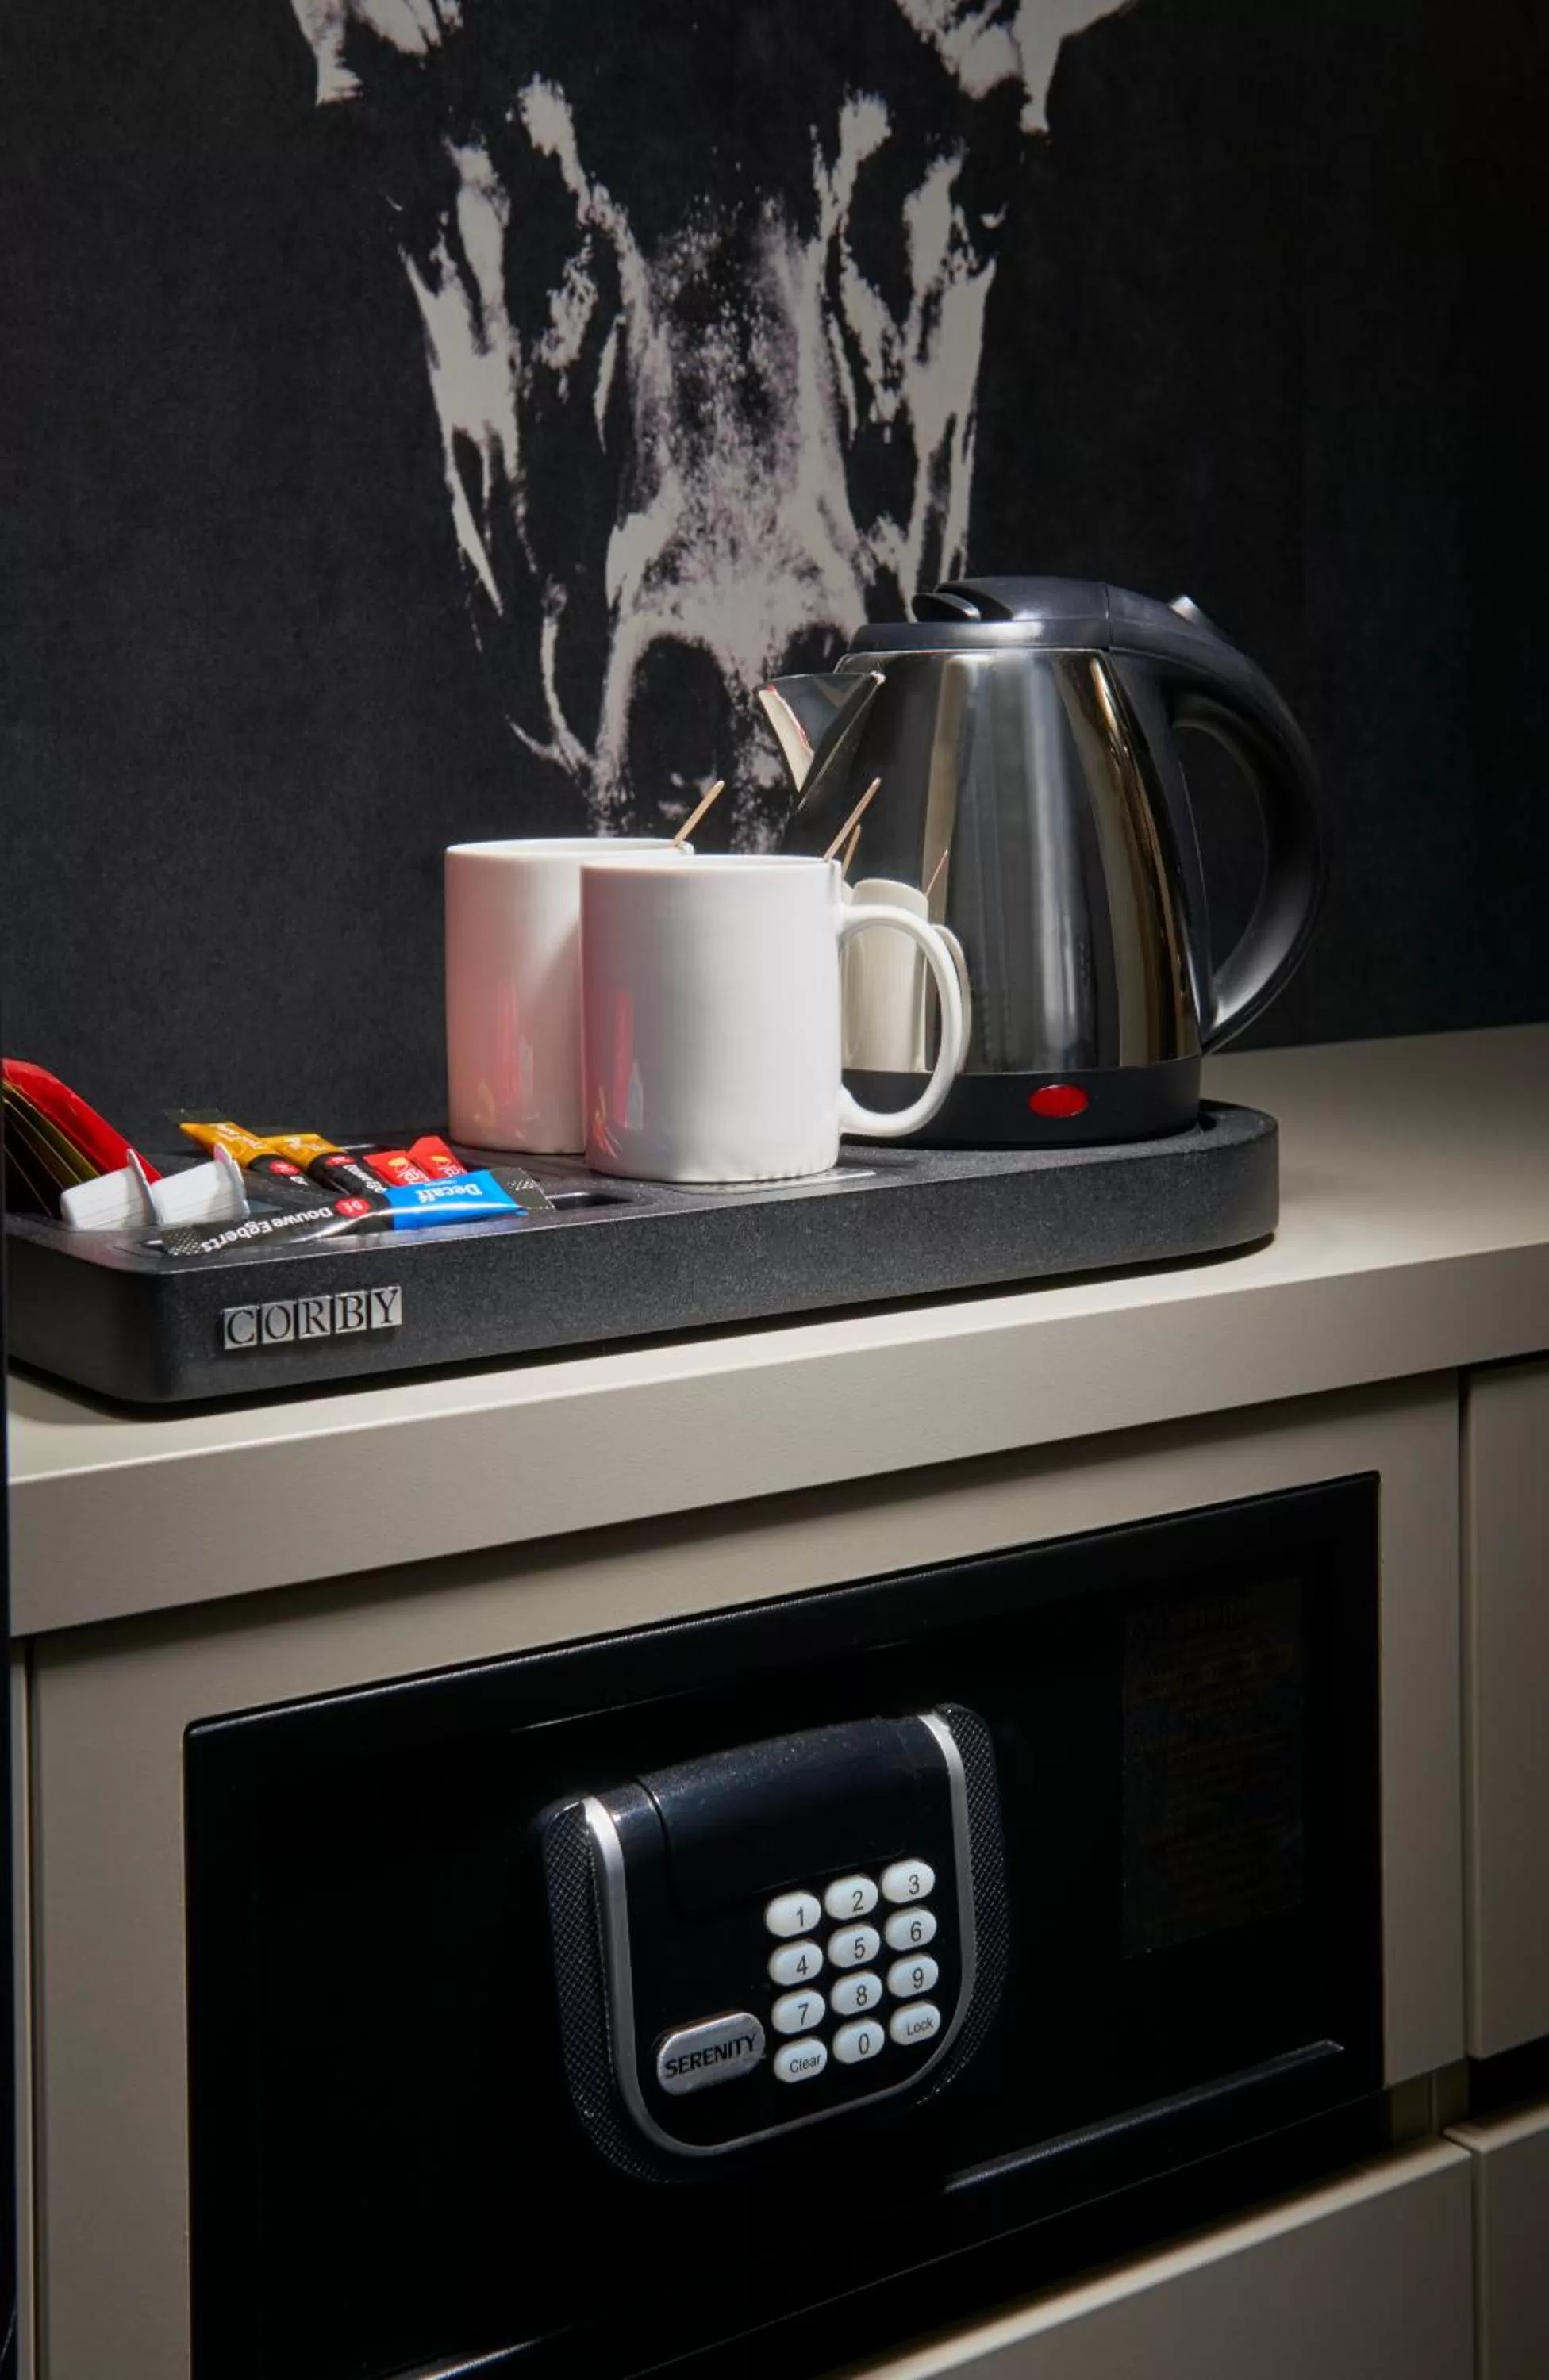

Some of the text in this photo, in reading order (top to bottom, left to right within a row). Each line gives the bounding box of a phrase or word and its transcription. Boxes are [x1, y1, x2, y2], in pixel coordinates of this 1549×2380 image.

[200, 1207, 335, 1253] Douwe Egberts
[227, 1289, 398, 1345] CORBY
[908, 1874, 920, 1895] 3
[851, 1890, 864, 1913] 2
[795, 1906, 805, 1927] 1
[910, 1921, 922, 1942] 6
[853, 1937, 866, 1960] 5
[795, 1955, 809, 1976] 4
[912, 1967, 924, 1989] 9
[855, 1984, 867, 2006] 8
[798, 2003, 809, 2025] 7
[906, 2016, 934, 2036] Lock
[858, 2033, 870, 2055] 0
[663, 2033, 757, 2079] SERENITY
[789, 2053, 822, 2074] Clear
